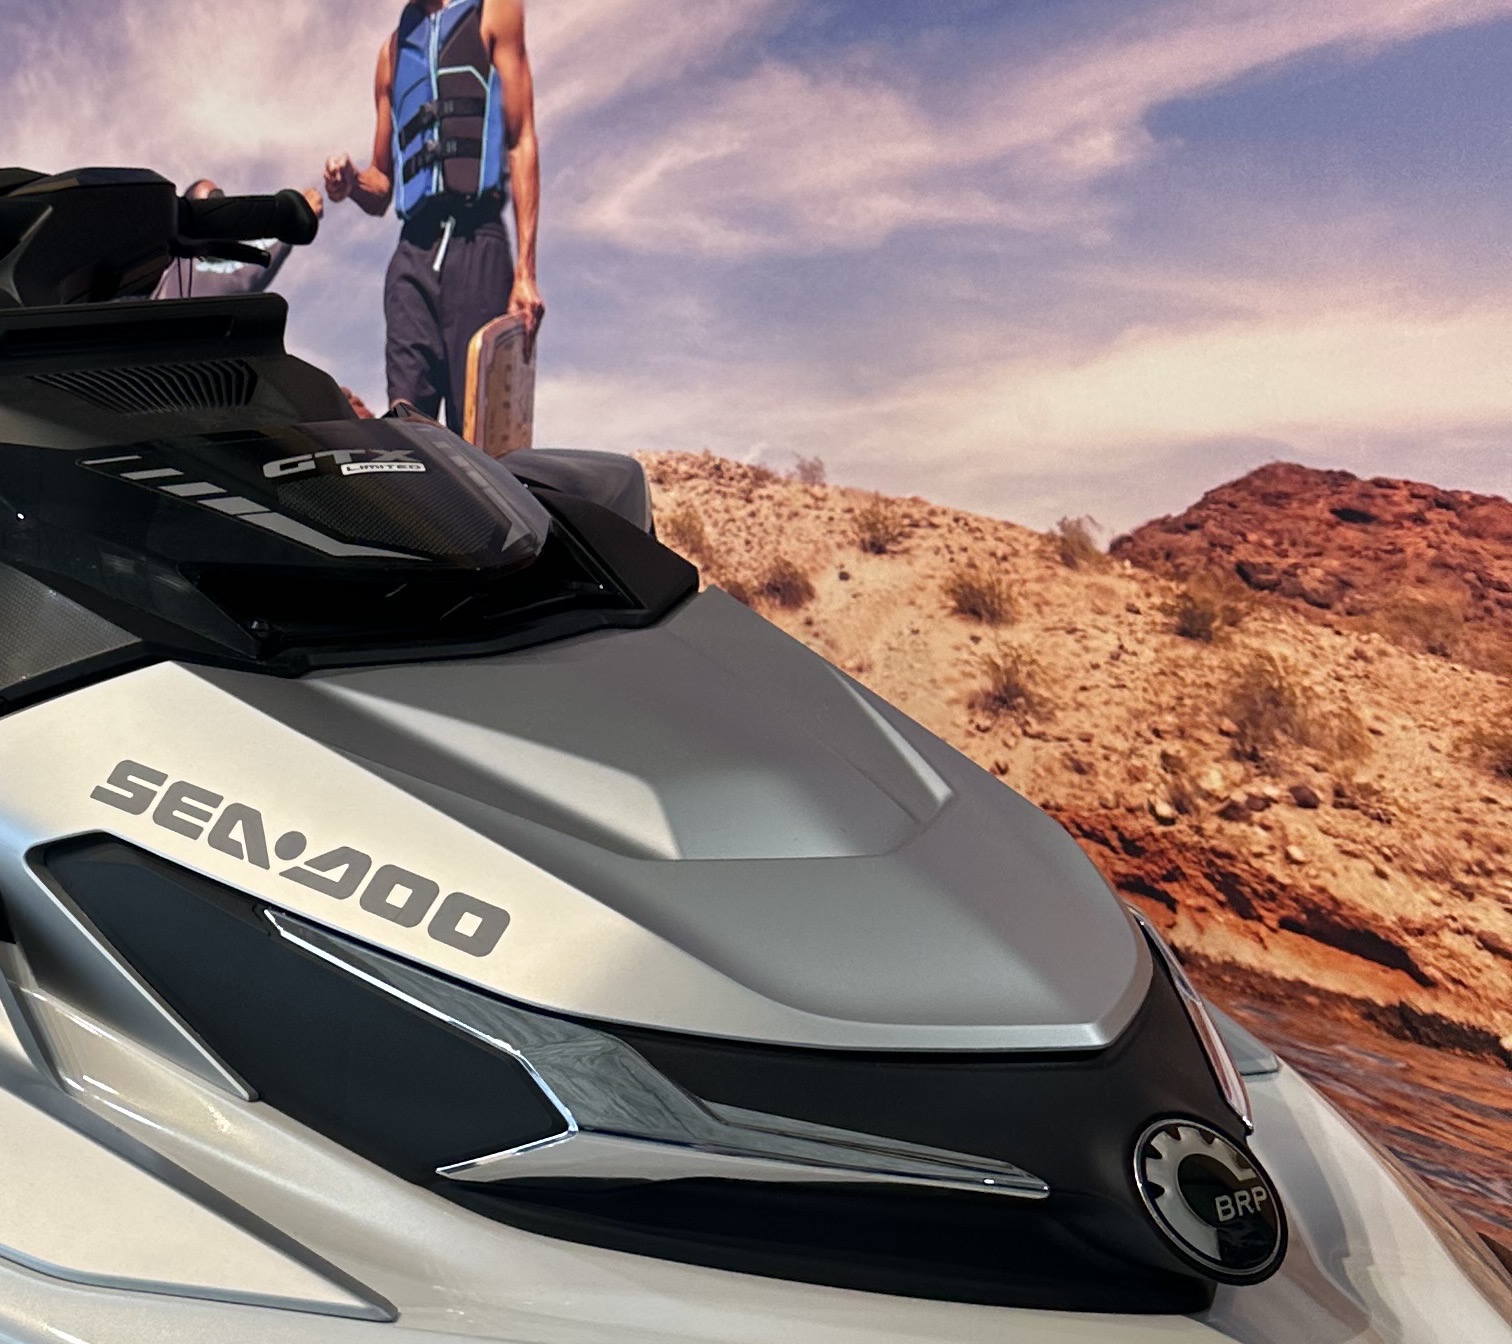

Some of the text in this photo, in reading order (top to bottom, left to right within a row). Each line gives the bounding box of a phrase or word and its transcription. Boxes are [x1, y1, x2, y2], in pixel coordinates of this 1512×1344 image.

[262, 448, 420, 479] GTX
[345, 463, 423, 473] LIMITED
[1214, 1185, 1268, 1223] BRP
